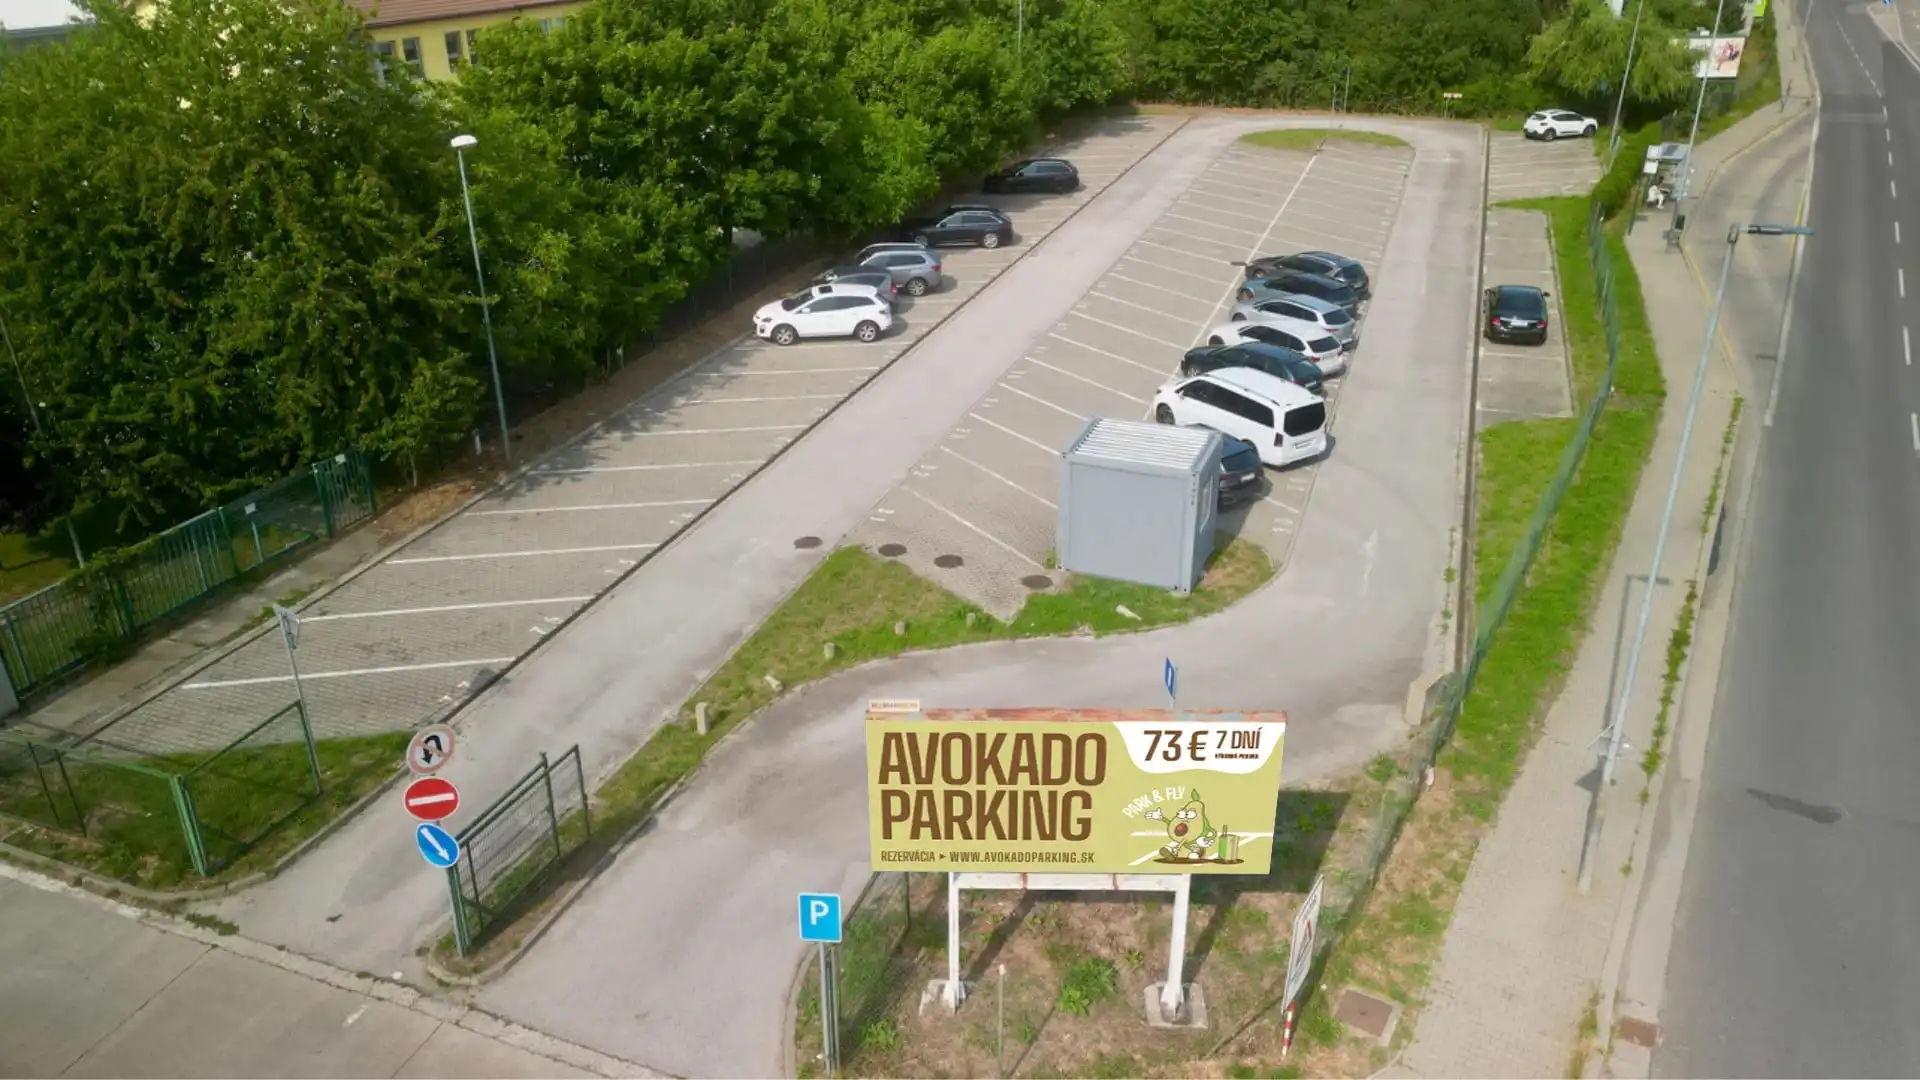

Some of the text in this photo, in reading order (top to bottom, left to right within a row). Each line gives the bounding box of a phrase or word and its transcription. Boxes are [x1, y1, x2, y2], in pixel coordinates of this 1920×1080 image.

[1144, 730, 1209, 762] 73 €
[1216, 727, 1262, 749] 7 DNÍ
[878, 732, 1107, 786] AVOKADO
[880, 789, 1092, 841] PARKING
[1122, 785, 1185, 818] PARK & FLY
[881, 850, 1095, 864] REZERVÁCIA WWW.AVOKADOPARKING.SK
[810, 900, 829, 925] P
